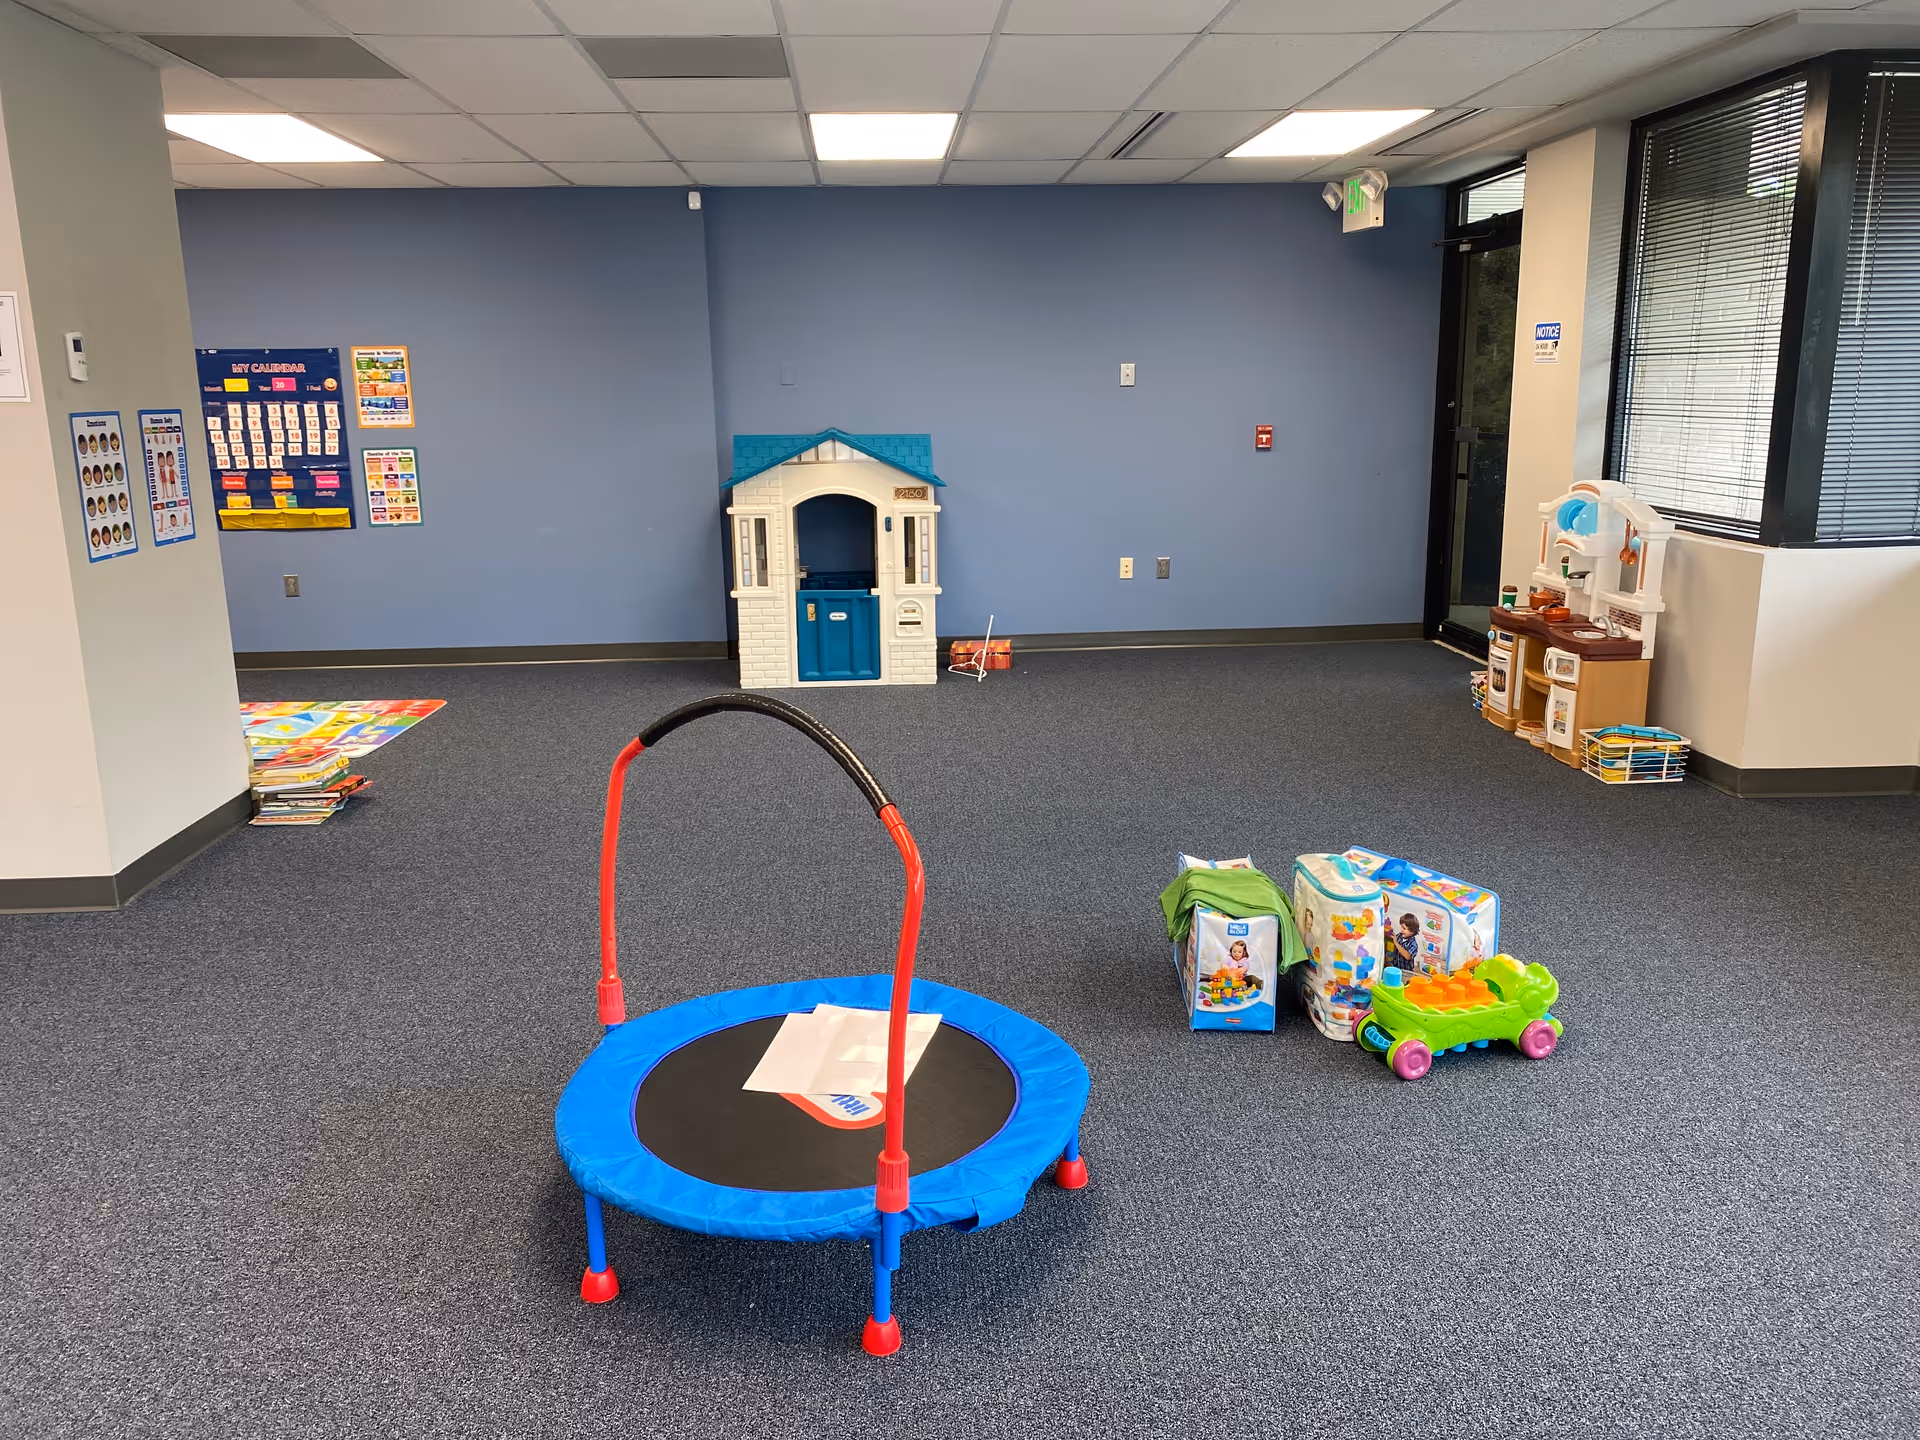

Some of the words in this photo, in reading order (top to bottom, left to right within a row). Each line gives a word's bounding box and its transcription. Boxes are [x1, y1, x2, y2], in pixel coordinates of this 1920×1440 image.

[1536, 325, 1560, 338] NOTICE
[232, 364, 250, 373] MY
[250, 363, 306, 373] CALENDAR
[831, 1096, 870, 1116] littl
